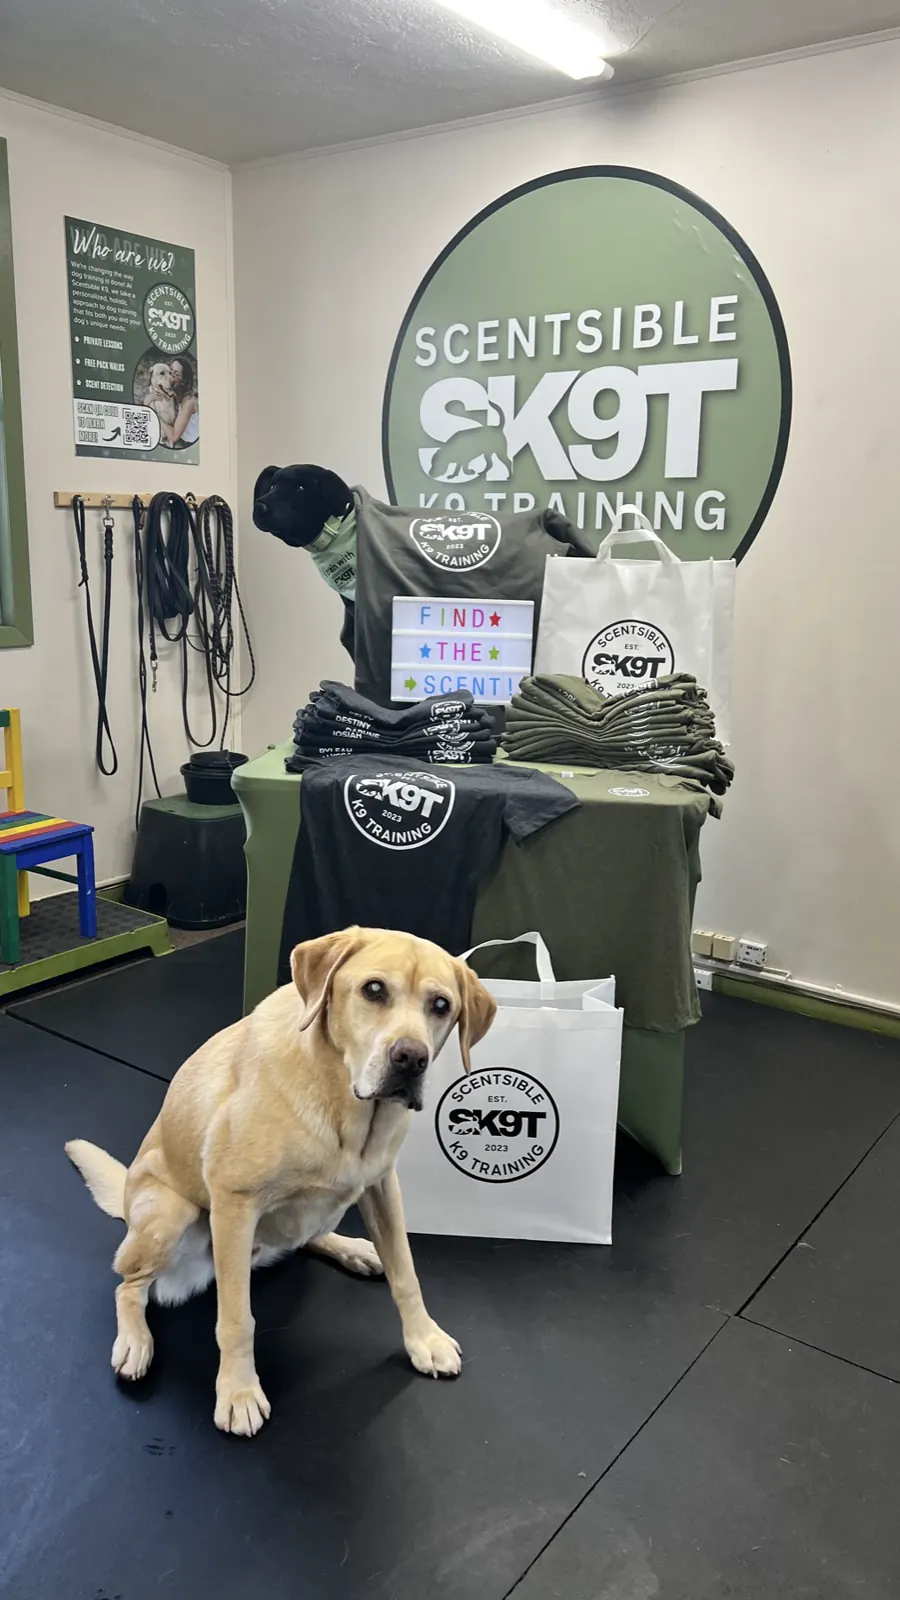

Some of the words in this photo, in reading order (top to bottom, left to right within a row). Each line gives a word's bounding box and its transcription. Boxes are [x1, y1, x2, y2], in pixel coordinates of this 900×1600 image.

[74, 226, 113, 259] Who
[116, 250, 146, 266] are
[148, 252, 174, 274] we?
[72, 270, 82, 280] dog
[84, 273, 104, 284] training
[88, 266, 112, 276] changing
[72, 279, 100, 290] Scentsible
[73, 299, 98, 308] approach
[106, 305, 116, 313] dog
[118, 308, 137, 318] training
[148, 286, 190, 311] SCENTSIBLE
[148, 326, 158, 340] K9
[158, 333, 191, 352] TRAINING
[414, 294, 738, 367] SCENTSIBLE
[84, 336, 102, 347] PRIVATE
[103, 339, 124, 350] LESSONS
[84, 358, 96, 368] FREE
[96, 360, 109, 370] PACK
[108, 362, 125, 372] WALKS
[86, 380, 100, 388] SCENT
[100, 381, 124, 392] DETECTION
[77, 402, 93, 415] SCAN
[104, 406, 118, 417] CODE
[78, 416, 86, 428] TO
[87, 418, 105, 430] LEARN
[418, 358, 738, 484] SK9T
[78, 430, 98, 442] MORE!
[419, 524, 492, 540] SK9T
[336, 551, 355, 566] with
[436, 544, 490, 566] TRAINING
[420, 606, 484, 628] FIND
[598, 625, 666, 652] SCENTSIBLE
[437, 642, 482, 662] THE
[592, 653, 666, 678] SK9T
[424, 675, 512, 696] SCENT!
[336, 715, 371, 730] DESTINY
[356, 779, 444, 818] SK9T
[352, 799, 367, 818] K9
[366, 818, 432, 843] TRAINING
[382, 810, 402, 822] 2023
[452, 1074, 544, 1104] SCENTSIBLE
[448, 1108, 546, 1138] SK9T
[449, 1140, 468, 1160] K9
[471, 1144, 544, 1176] TRAINING
[485, 1144, 508, 1152] 2023
